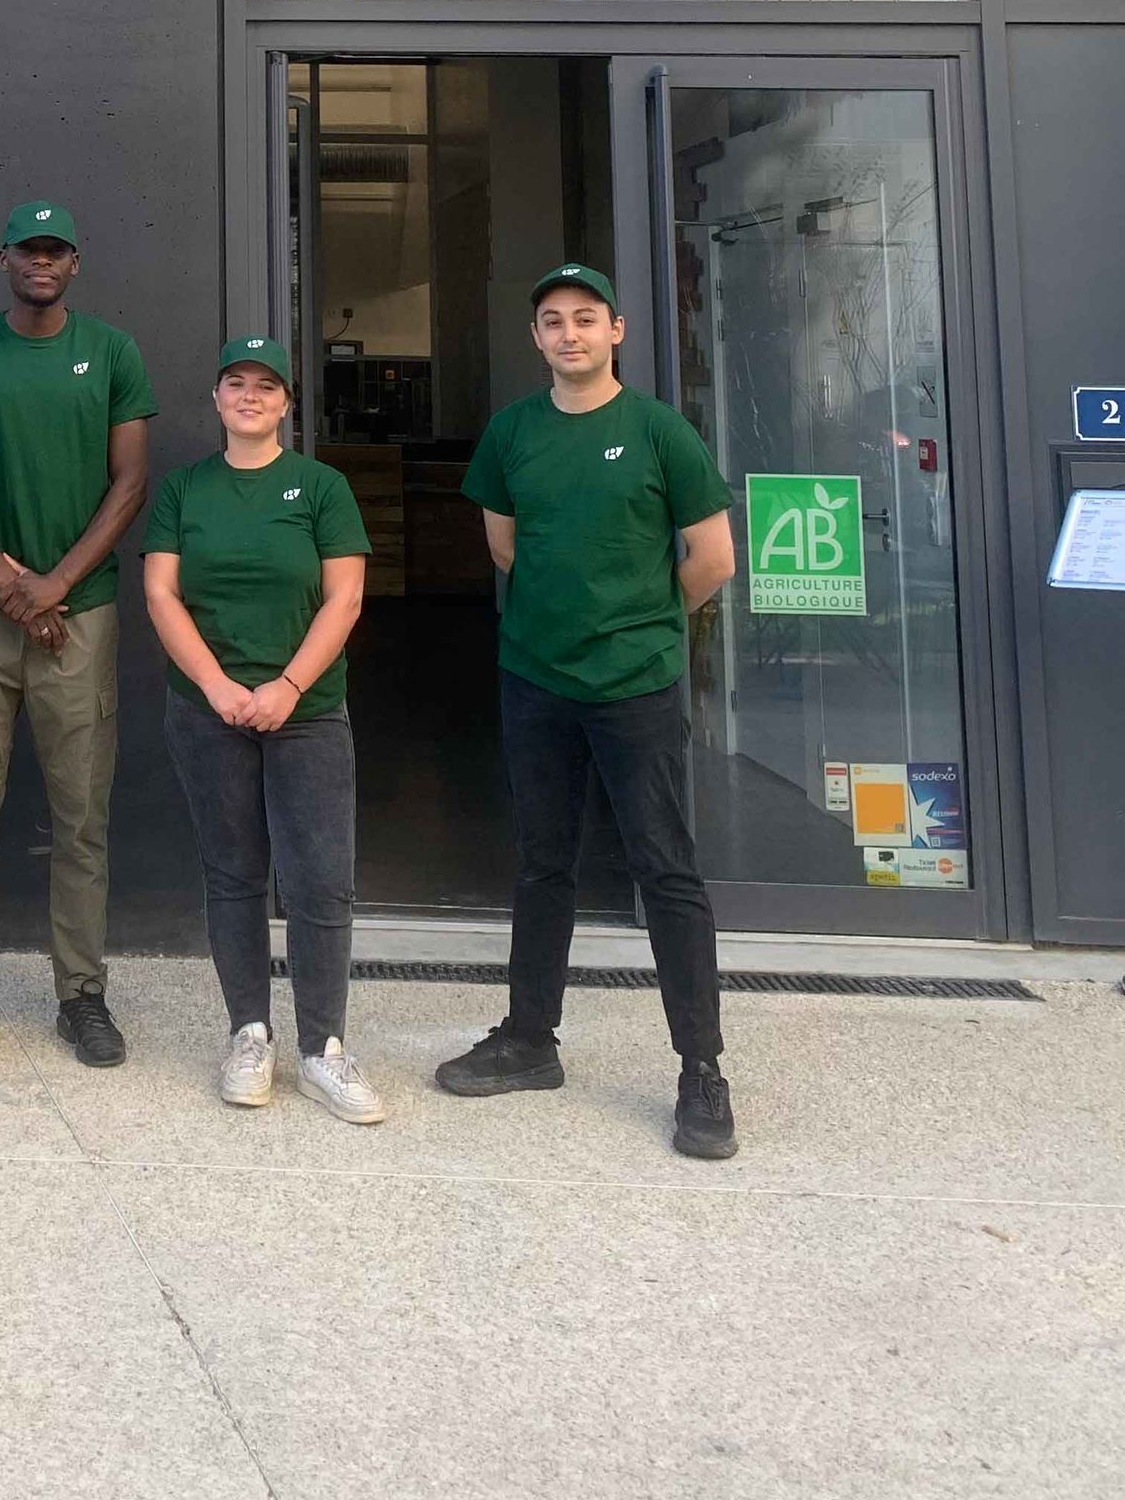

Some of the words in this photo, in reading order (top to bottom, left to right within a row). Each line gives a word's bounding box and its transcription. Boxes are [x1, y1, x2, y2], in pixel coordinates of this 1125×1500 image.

[1102, 400, 1121, 424] 2
[759, 508, 843, 570] AB
[753, 579, 863, 591] AGRICULTURE
[754, 595, 863, 608] BIOLOGIQUE
[911, 770, 956, 782] sodexo
